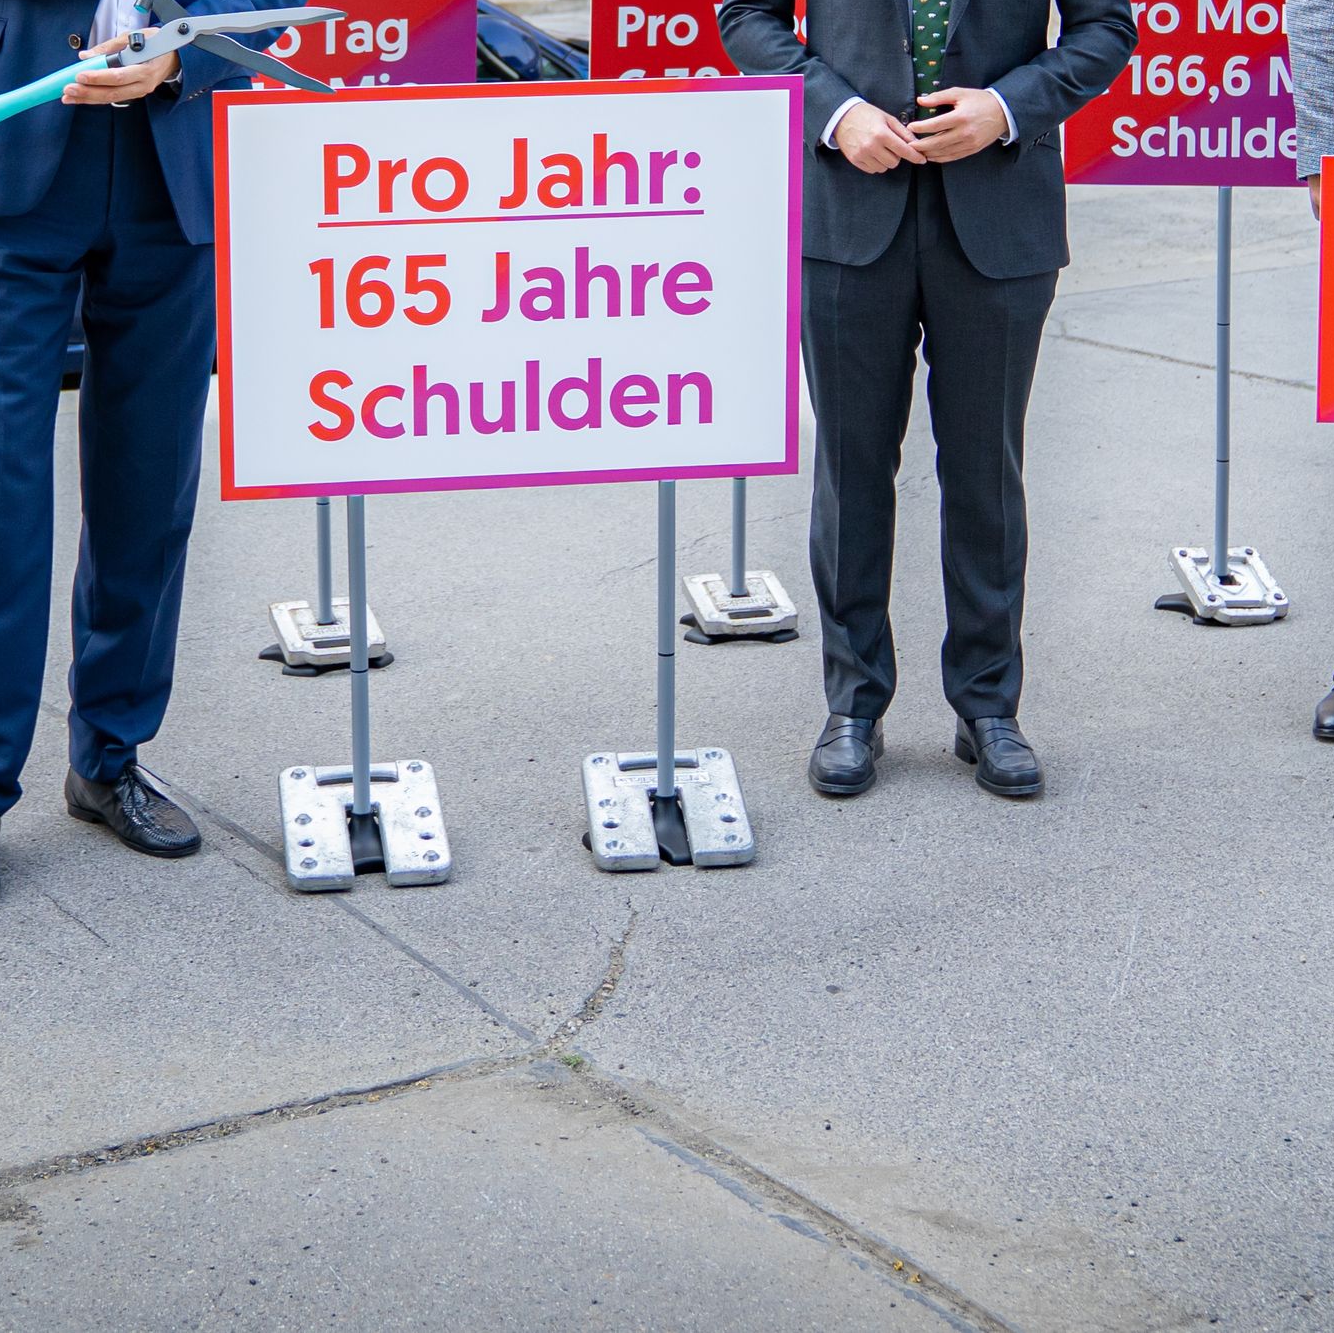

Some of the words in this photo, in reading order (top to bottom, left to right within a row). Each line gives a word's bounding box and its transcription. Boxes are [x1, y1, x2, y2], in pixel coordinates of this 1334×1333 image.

[325, 17, 408, 62] Tag
[617, 5, 699, 48] Pro
[1130, 2, 1180, 34] ro
[1128, 55, 1251, 104] 166,6
[1111, 116, 1297, 159] Schulde
[323, 142, 469, 215] Pro
[499, 133, 702, 210] Jahr:
[309, 254, 451, 329] 165
[481, 246, 714, 322] Jahre
[307, 356, 714, 441] Schulden
